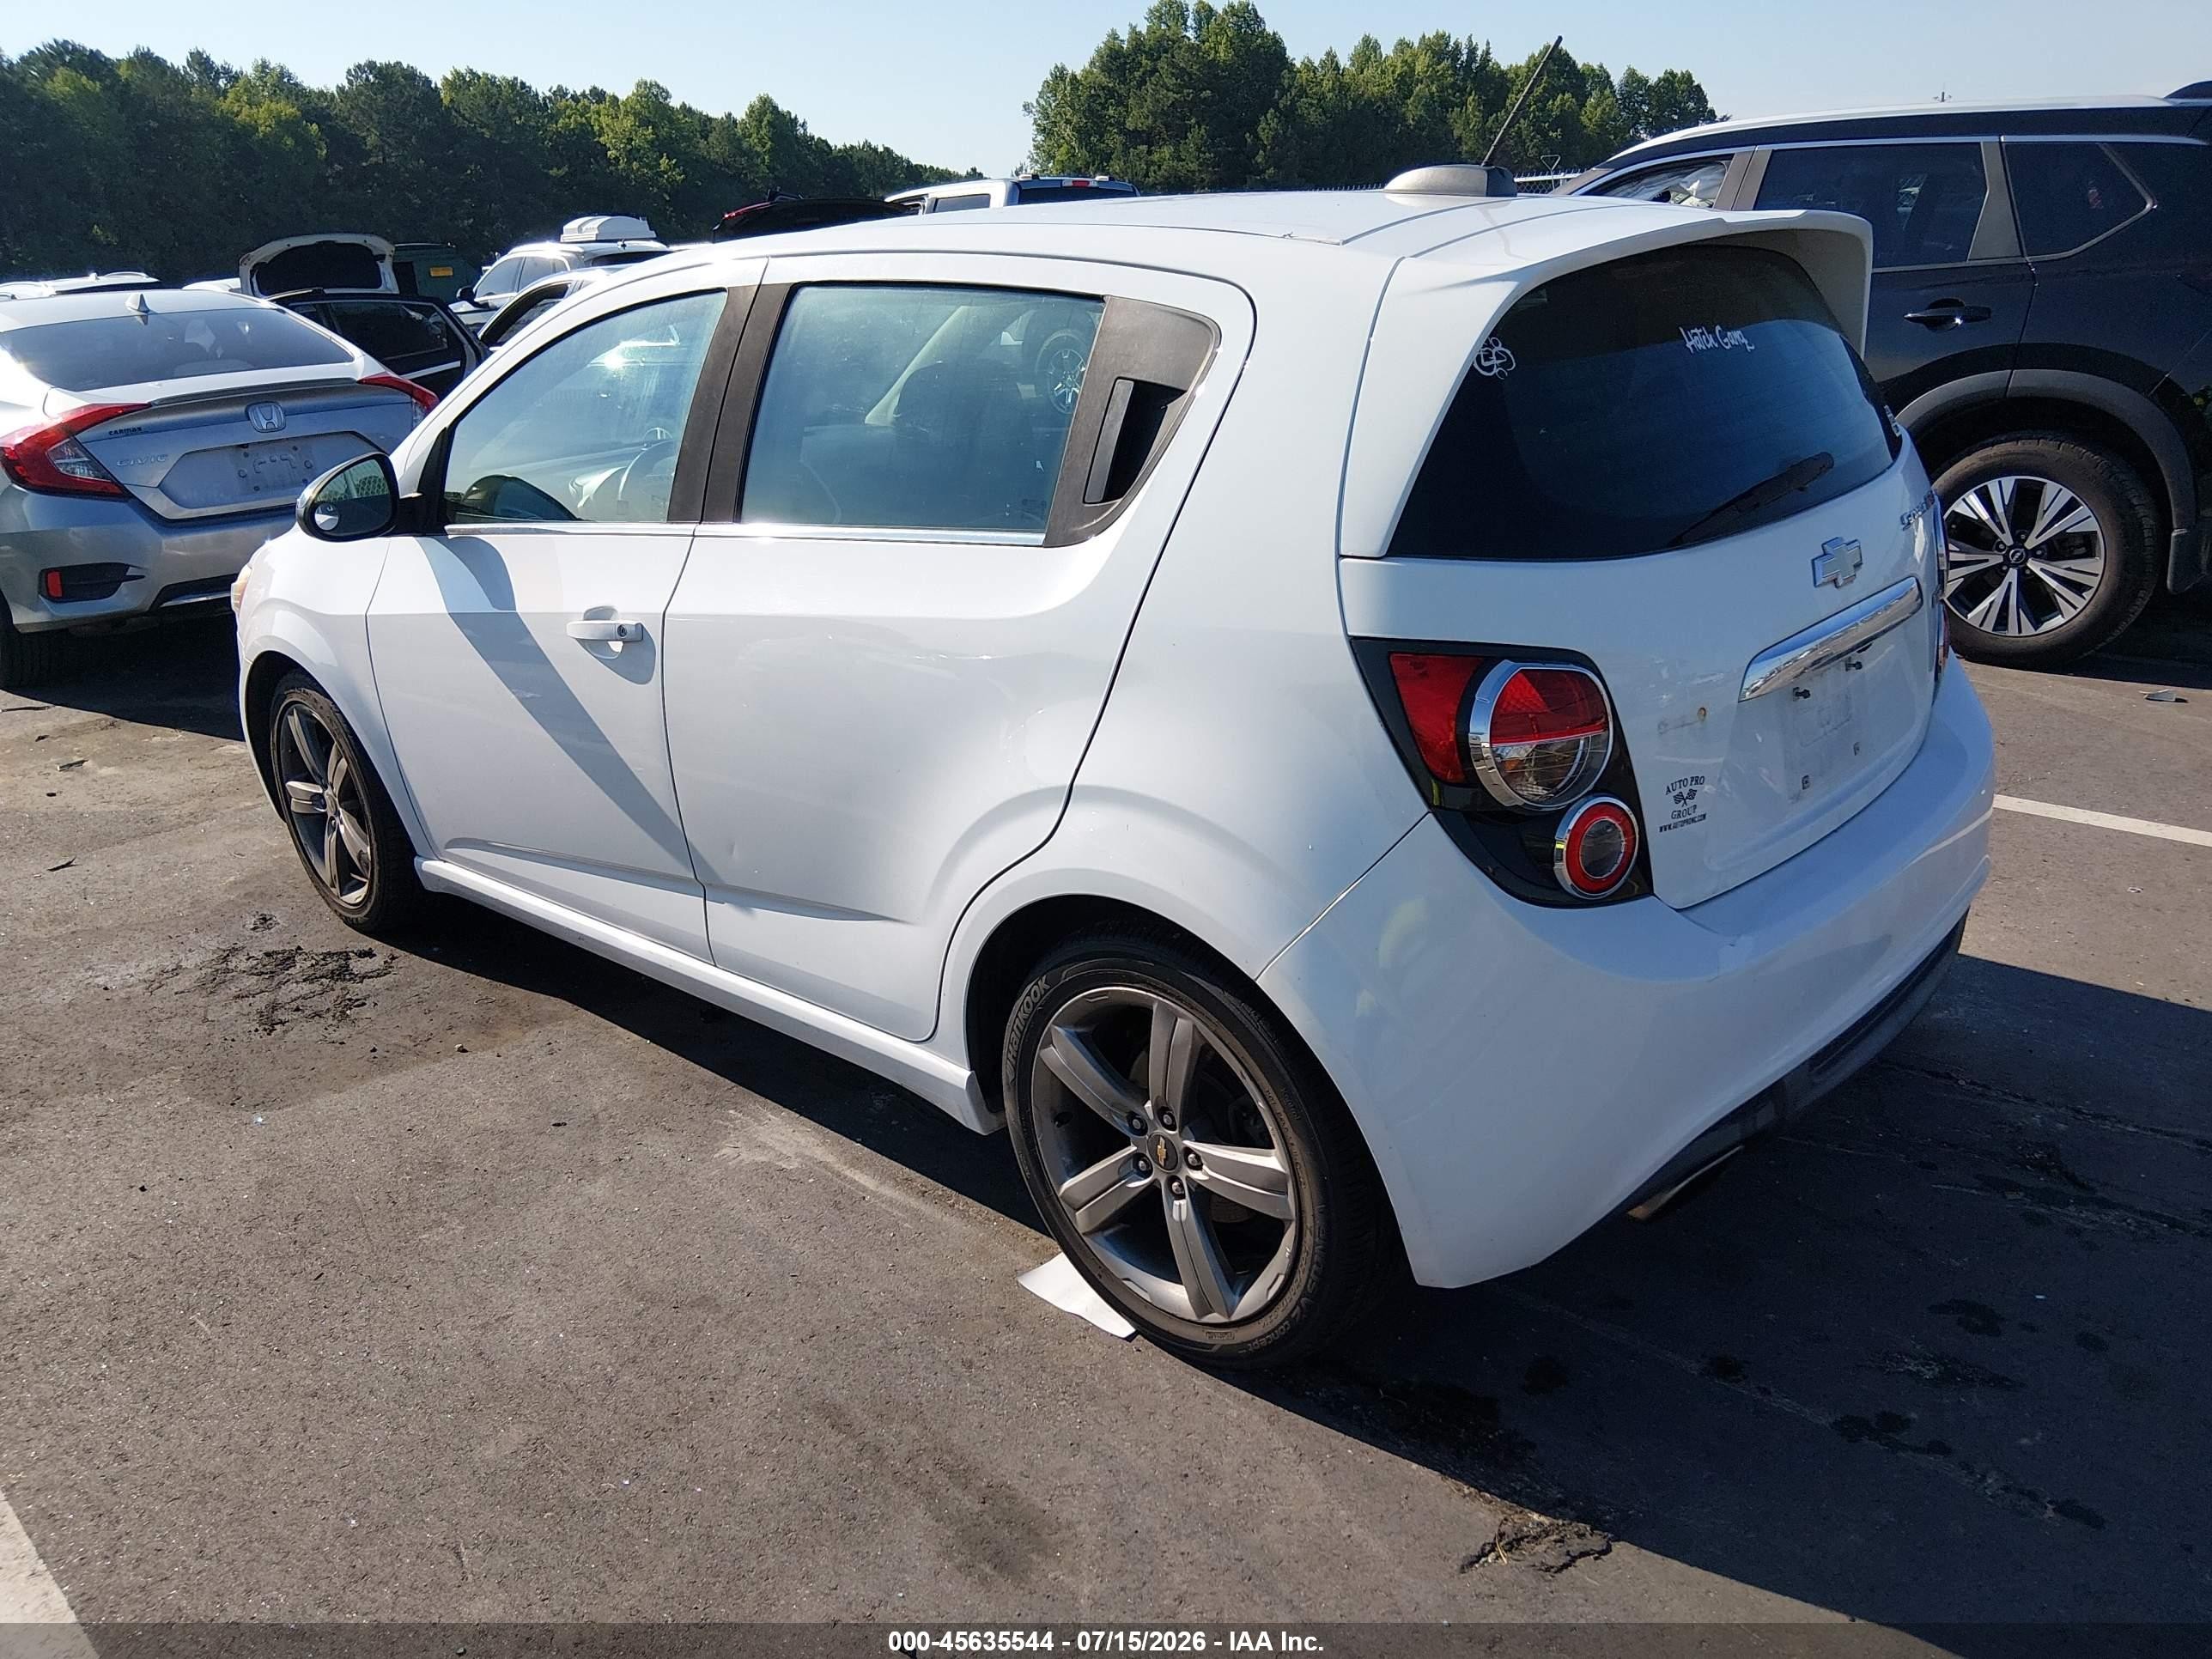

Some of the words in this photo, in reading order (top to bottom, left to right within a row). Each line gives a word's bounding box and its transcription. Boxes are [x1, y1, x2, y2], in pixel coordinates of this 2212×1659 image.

[116, 453, 168, 467] CIVIC
[1665, 777, 1688, 795] AUTO
[1690, 775, 1705, 787] PRO
[1671, 805, 1698, 820] GROUP
